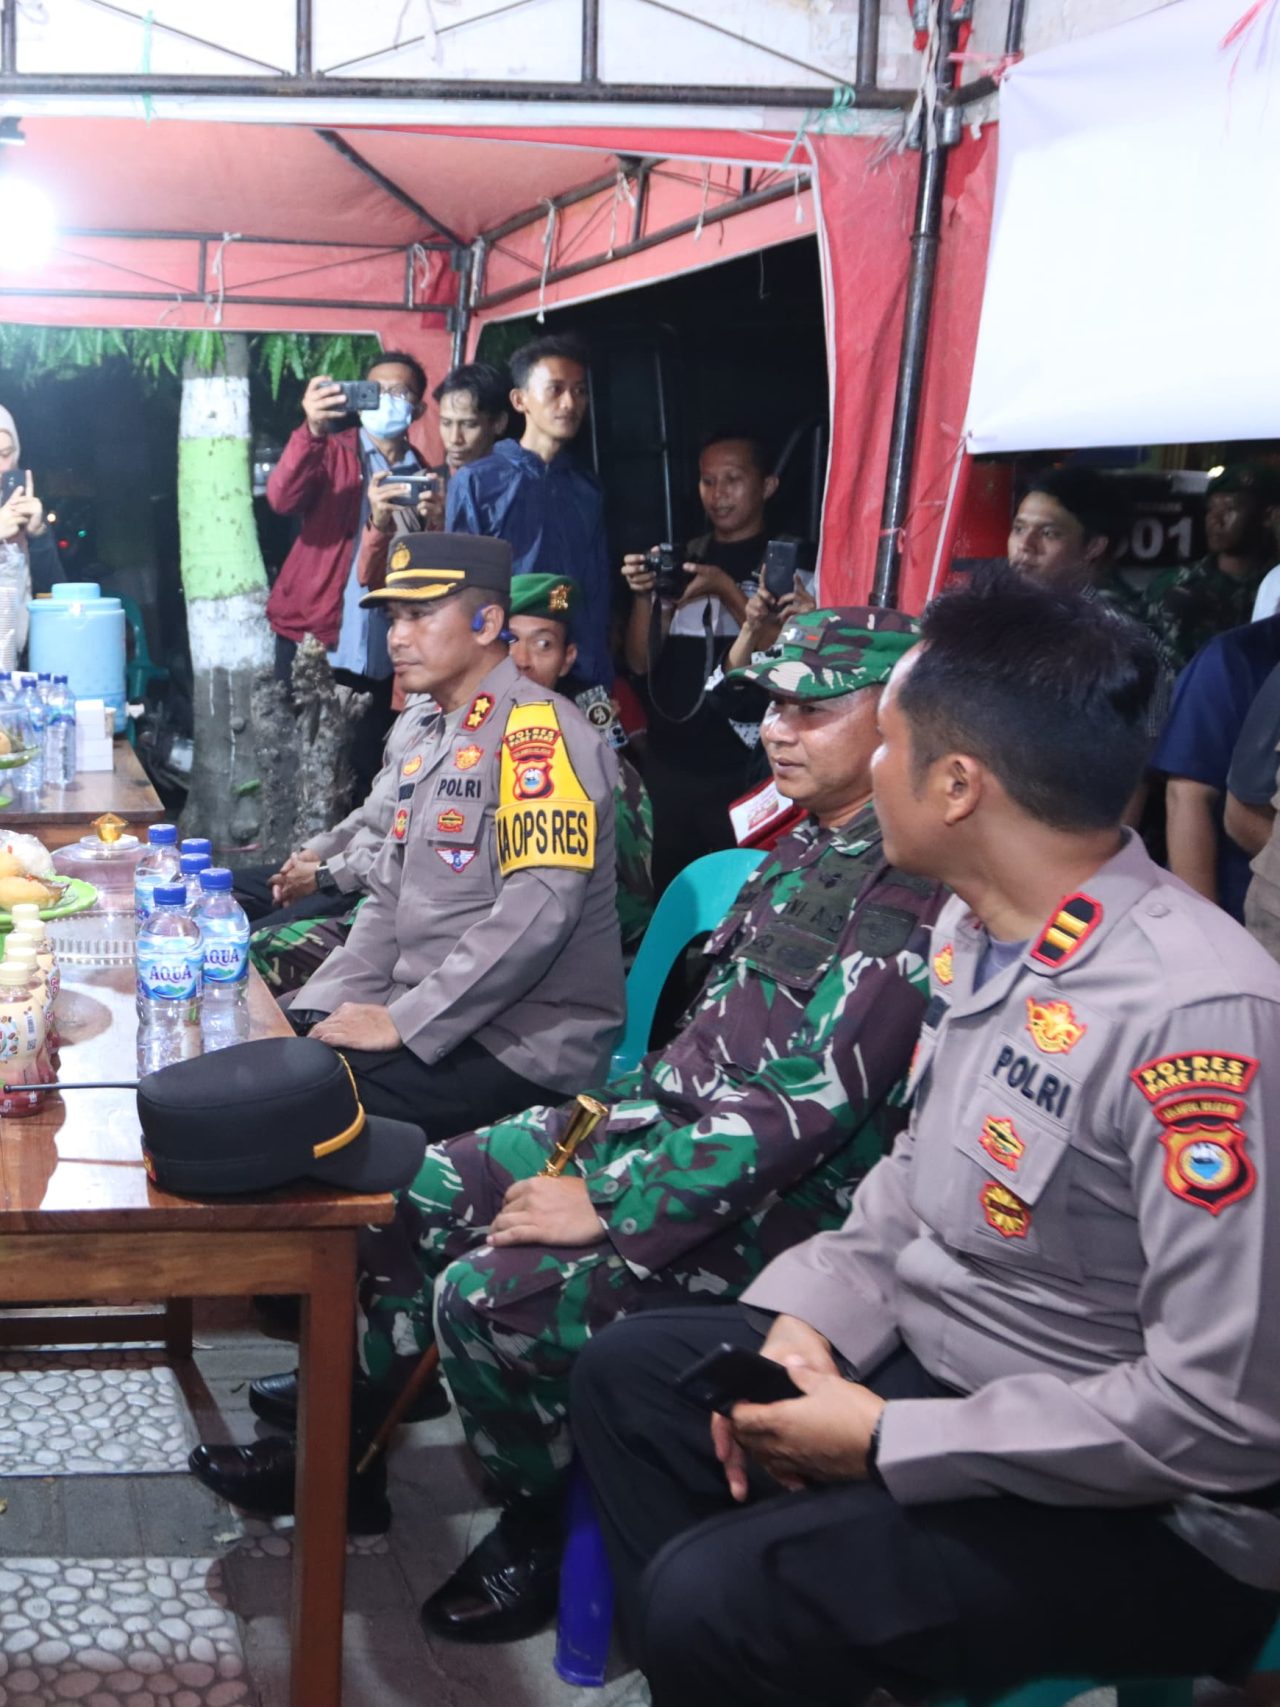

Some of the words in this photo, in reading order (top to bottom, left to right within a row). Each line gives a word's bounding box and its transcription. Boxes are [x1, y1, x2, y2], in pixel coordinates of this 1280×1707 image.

[437, 778, 481, 799] POLRI
[149, 965, 193, 984] AQUA
[992, 1044, 1073, 1120] POLRI
[1141, 1056, 1245, 1086] POLRES
[1146, 1072, 1191, 1096] PARE
